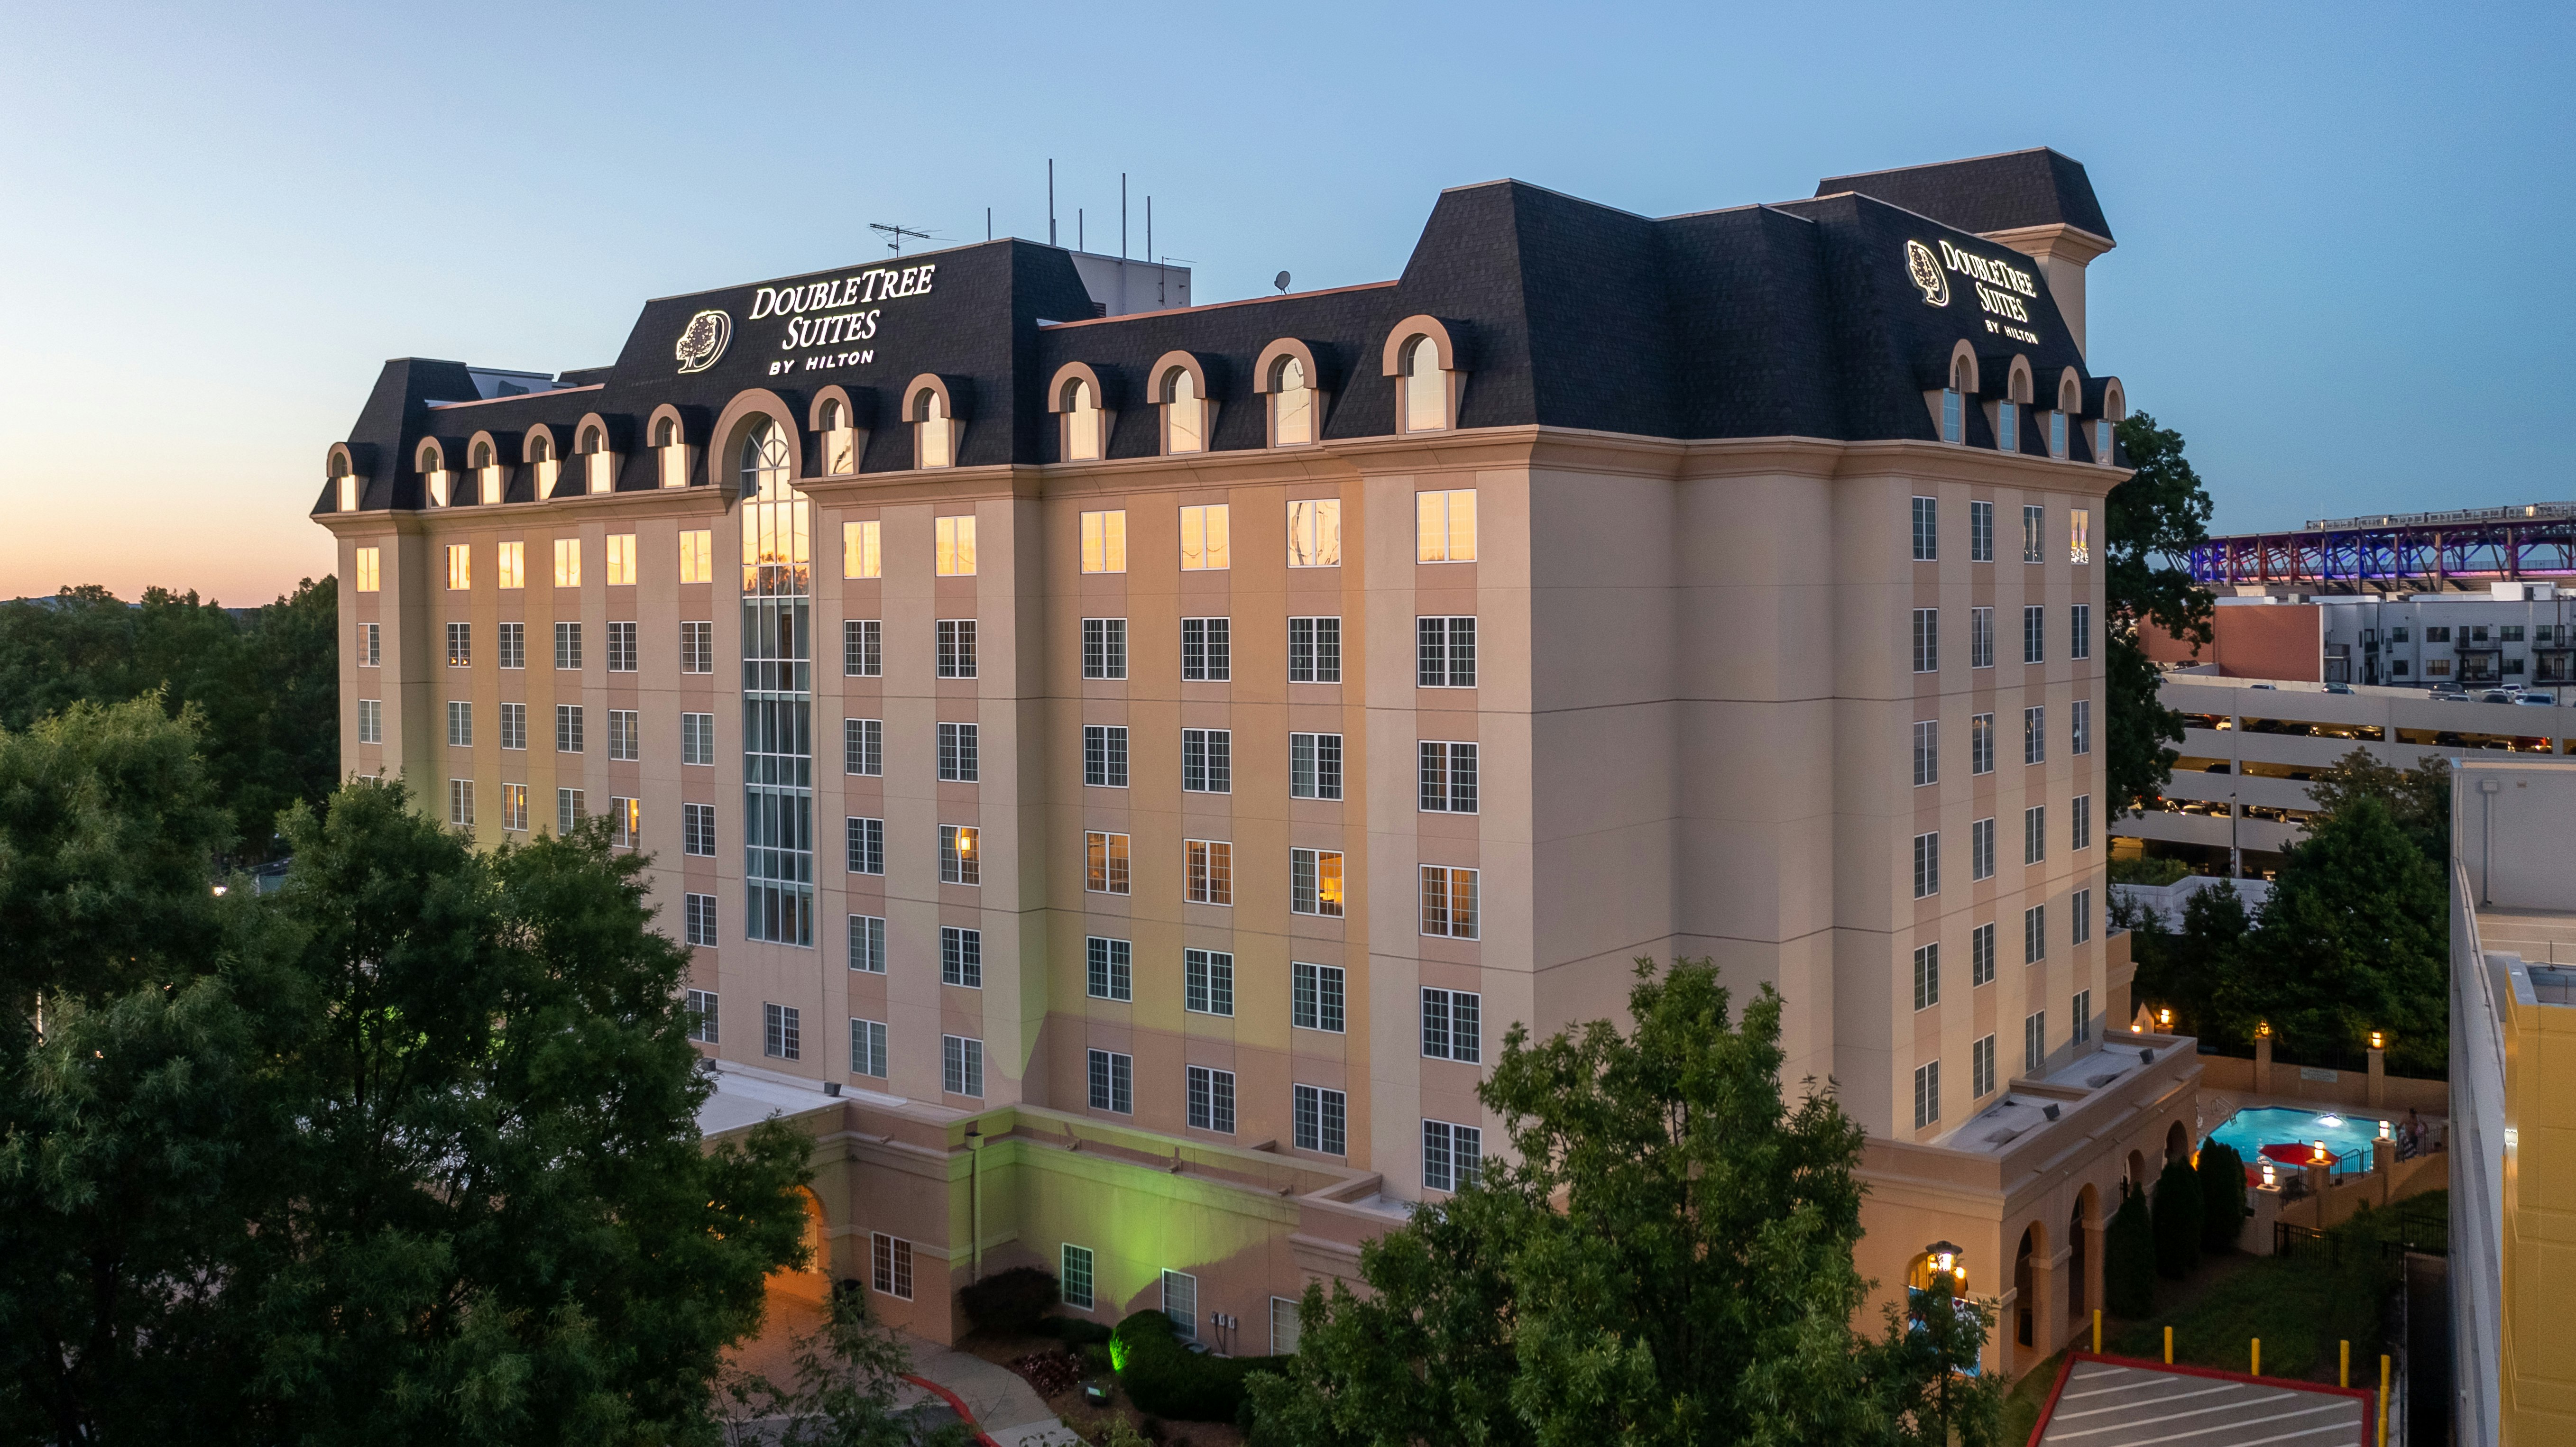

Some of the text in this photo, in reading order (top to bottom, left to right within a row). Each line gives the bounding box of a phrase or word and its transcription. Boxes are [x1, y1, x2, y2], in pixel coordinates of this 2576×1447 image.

[1938, 239, 2037, 298] DOUBLETREE
[749, 264, 935, 320] DOUBLETREE
[1975, 281, 2028, 323] SUITES
[782, 309, 880, 350] SUITES
[1985, 320, 2038, 345] BY HILTON
[769, 349, 874, 375] BY HILTON
